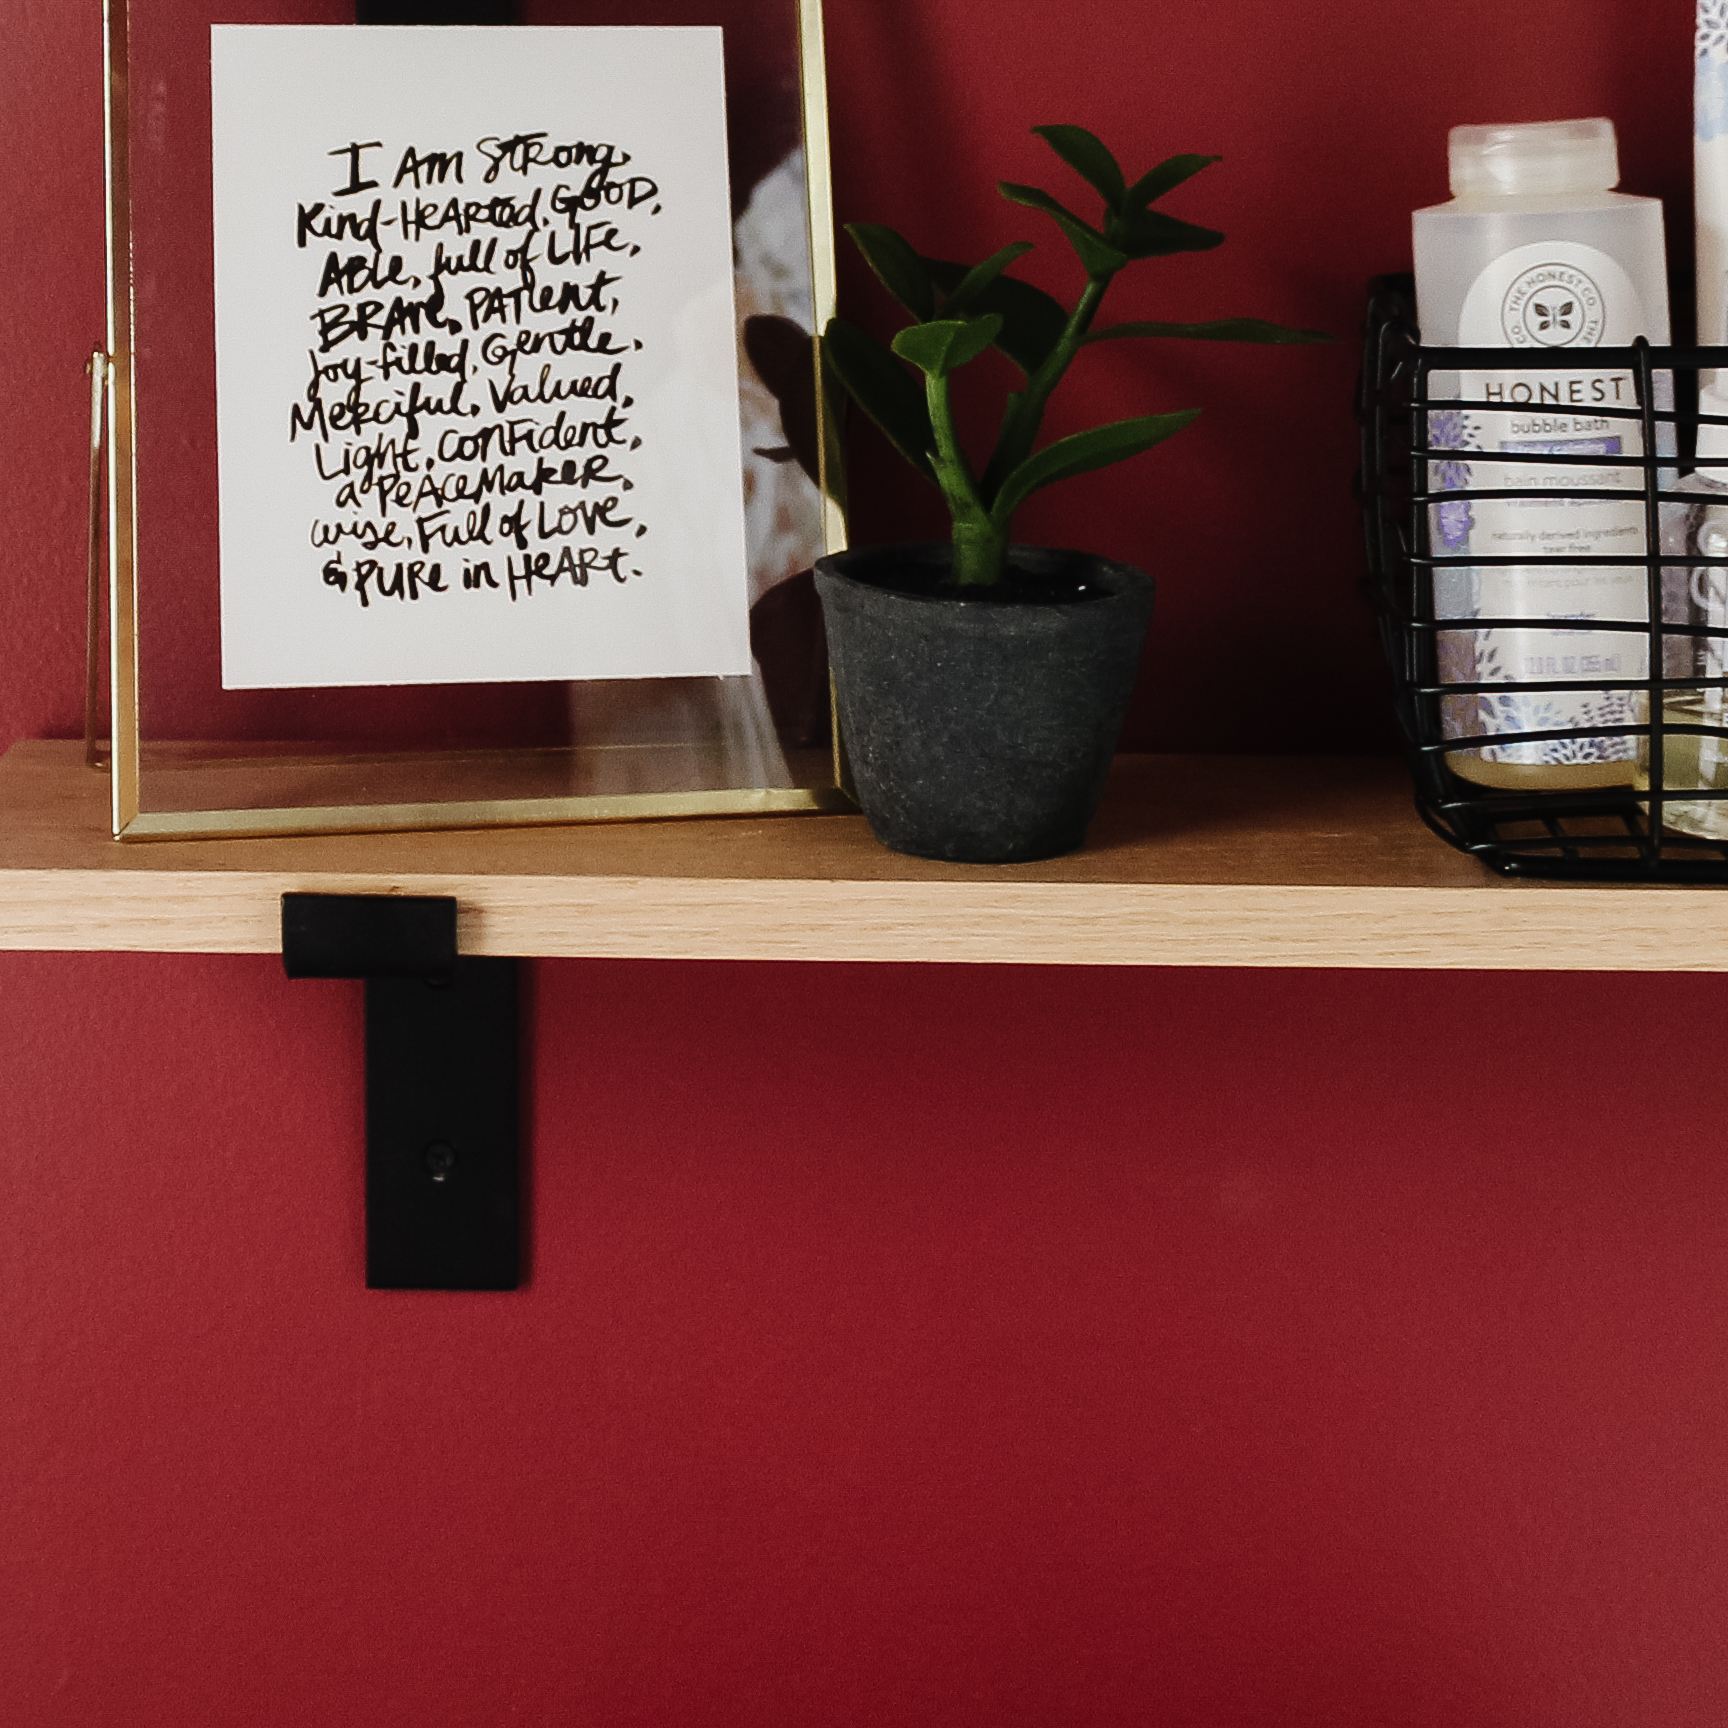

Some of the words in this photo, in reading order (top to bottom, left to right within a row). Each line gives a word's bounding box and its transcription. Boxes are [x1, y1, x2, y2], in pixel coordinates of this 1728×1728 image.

[328, 141, 383, 197] I
[1508, 286, 1528, 313] THE
[1524, 270, 1583, 289] HONEST
[1485, 376, 1626, 404] HONEST
[1510, 418, 1568, 434] bubble
[1573, 417, 1610, 432] bath
[498, 497, 532, 551] of
[462, 555, 500, 590] in
